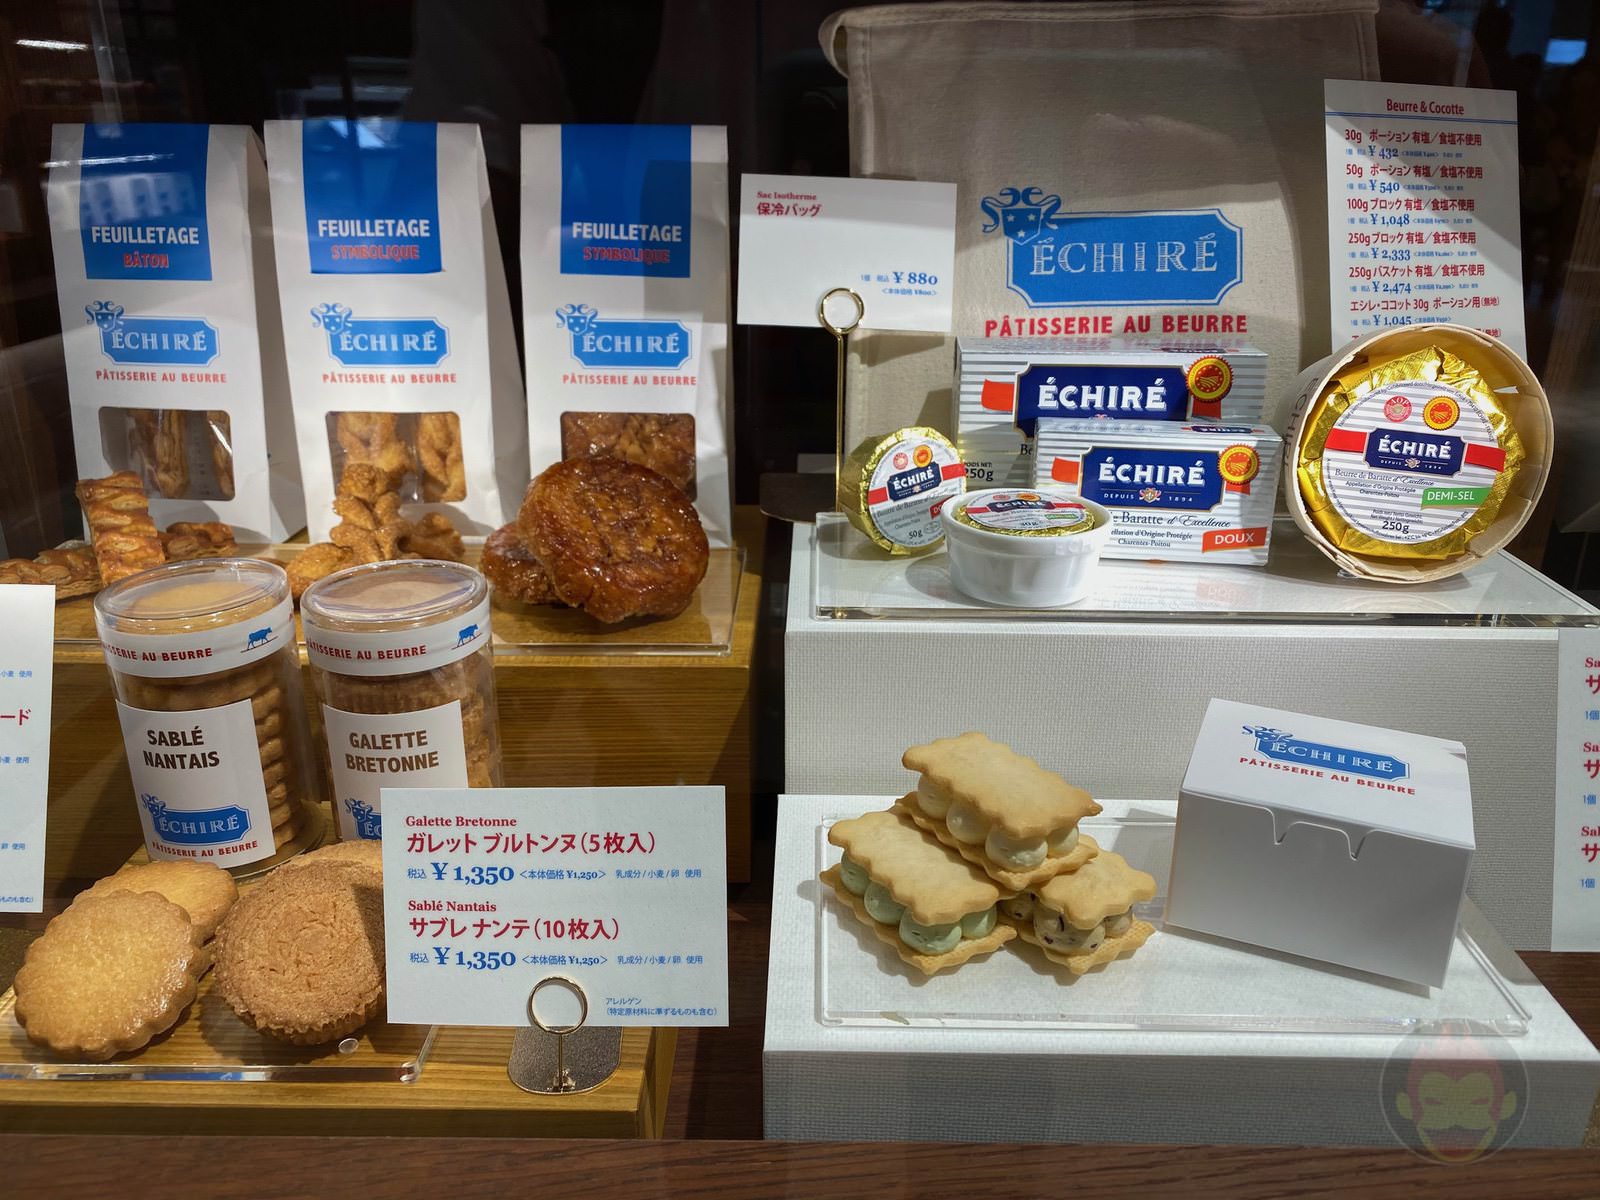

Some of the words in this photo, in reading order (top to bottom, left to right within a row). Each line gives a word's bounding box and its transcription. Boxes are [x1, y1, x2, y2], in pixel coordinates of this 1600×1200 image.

[1387, 99, 1418, 112] Beurre
[1420, 101, 1428, 112] &
[1429, 101, 1465, 115] Cocotte
[1345, 129, 1362, 143] 30g
[1369, 129, 1409, 142] ポーション
[1346, 163, 1363, 178] 50g
[1370, 163, 1411, 176] ポーション
[757, 191, 772, 199] Sac
[774, 191, 817, 201] Isotherme
[757, 202, 822, 217] 保冷バッグ
[1347, 198, 1368, 212] 100g
[1371, 198, 1402, 210] ブロック
[91, 227, 200, 244] FEUILLETAGE
[318, 219, 431, 237] FEUILLETAGE
[572, 222, 682, 242] FEUILLETAGE
[1348, 232, 1371, 246] 250g
[1372, 232, 1404, 244] ブロック
[124, 251, 170, 268] BÂTON
[331, 245, 420, 262] SYMBOLIQUE
[583, 247, 671, 265] SYMBOLIQUE
[1029, 232, 1218, 276] ÉCHIRÉ
[893, 271, 938, 285] ¥880
[1349, 266, 1372, 280] 250g
[1374, 265, 1413, 277] バスケット
[1414, 298, 1429, 312] 30g
[985, 315, 1113, 337] PÂTISSERIE
[1123, 316, 1151, 334] AU
[1162, 314, 1248, 334] BEURRE
[111, 329, 207, 352] ÉCHIRÉ
[340, 330, 438, 352] ÉCHIRÉ
[582, 332, 680, 353] ÉCHIRÉ
[96, 369, 157, 382] PÂTISSERIE
[162, 372, 176, 383] AU
[182, 373, 227, 383] BEURRE
[323, 372, 386, 384] PÂTISSERIE
[391, 374, 405, 384] AU
[411, 373, 457, 384] BEURRE
[563, 373, 628, 385] PÂTISSERIE
[634, 376, 648, 385] AU
[653, 376, 697, 386] BEURRE
[1037, 376, 1167, 411] ÉCHIRÉ
[1378, 435, 1451, 460] ÉCHIRÉ
[893, 466, 935, 490] ÉCHIRÉ
[1098, 456, 1205, 487] ÉCHIRÉ
[1335, 469, 1358, 478] Beurre
[1368, 472, 1392, 482] Baratte
[1428, 491, 1474, 501] DEMI-SEL
[1122, 511, 1164, 525] Baratte
[1137, 529, 1165, 539] d'Origine
[1382, 521, 1410, 534] 250g
[1118, 538, 1171, 548] Charentes-Poitou
[1215, 533, 1254, 545] DOUX
[142, 652, 157, 661] AU
[162, 648, 213, 662] BEURRE
[357, 650, 372, 660] AU
[378, 645, 427, 660] BEURRE
[147, 726, 204, 747] SABLÉ
[350, 730, 428, 750] GALETTE
[143, 750, 220, 769] NANTAIS
[345, 751, 440, 773] BRETONNE
[1270, 741, 1393, 773] ÉCHIRÉ
[1240, 757, 1324, 778] PÂTISSERIE
[1331, 774, 1350, 783] AU
[1357, 778, 1417, 795] BEURRE
[158, 814, 240, 835] ÉCHIRÉ
[406, 816, 452, 827] Galette
[455, 816, 518, 827] Bretonne
[153, 841, 197, 858] PÂTISSERIE
[200, 848, 214, 857] AU
[219, 840, 258, 856] BEURRE
[406, 832, 477, 854] ガレット
[408, 868, 427, 879] 税込
[431, 862, 515, 886] ¥1,350
[685, 869, 702, 879] 使用
[408, 900, 443, 912] Sablé
[447, 901, 497, 912] Nantais
[409, 916, 467, 938] サブレ
[410, 952, 429, 964] 税込
[432, 946, 517, 970] ¥1,350
[686, 955, 704, 965] 使用
[606, 997, 642, 1006] アレルゲン
